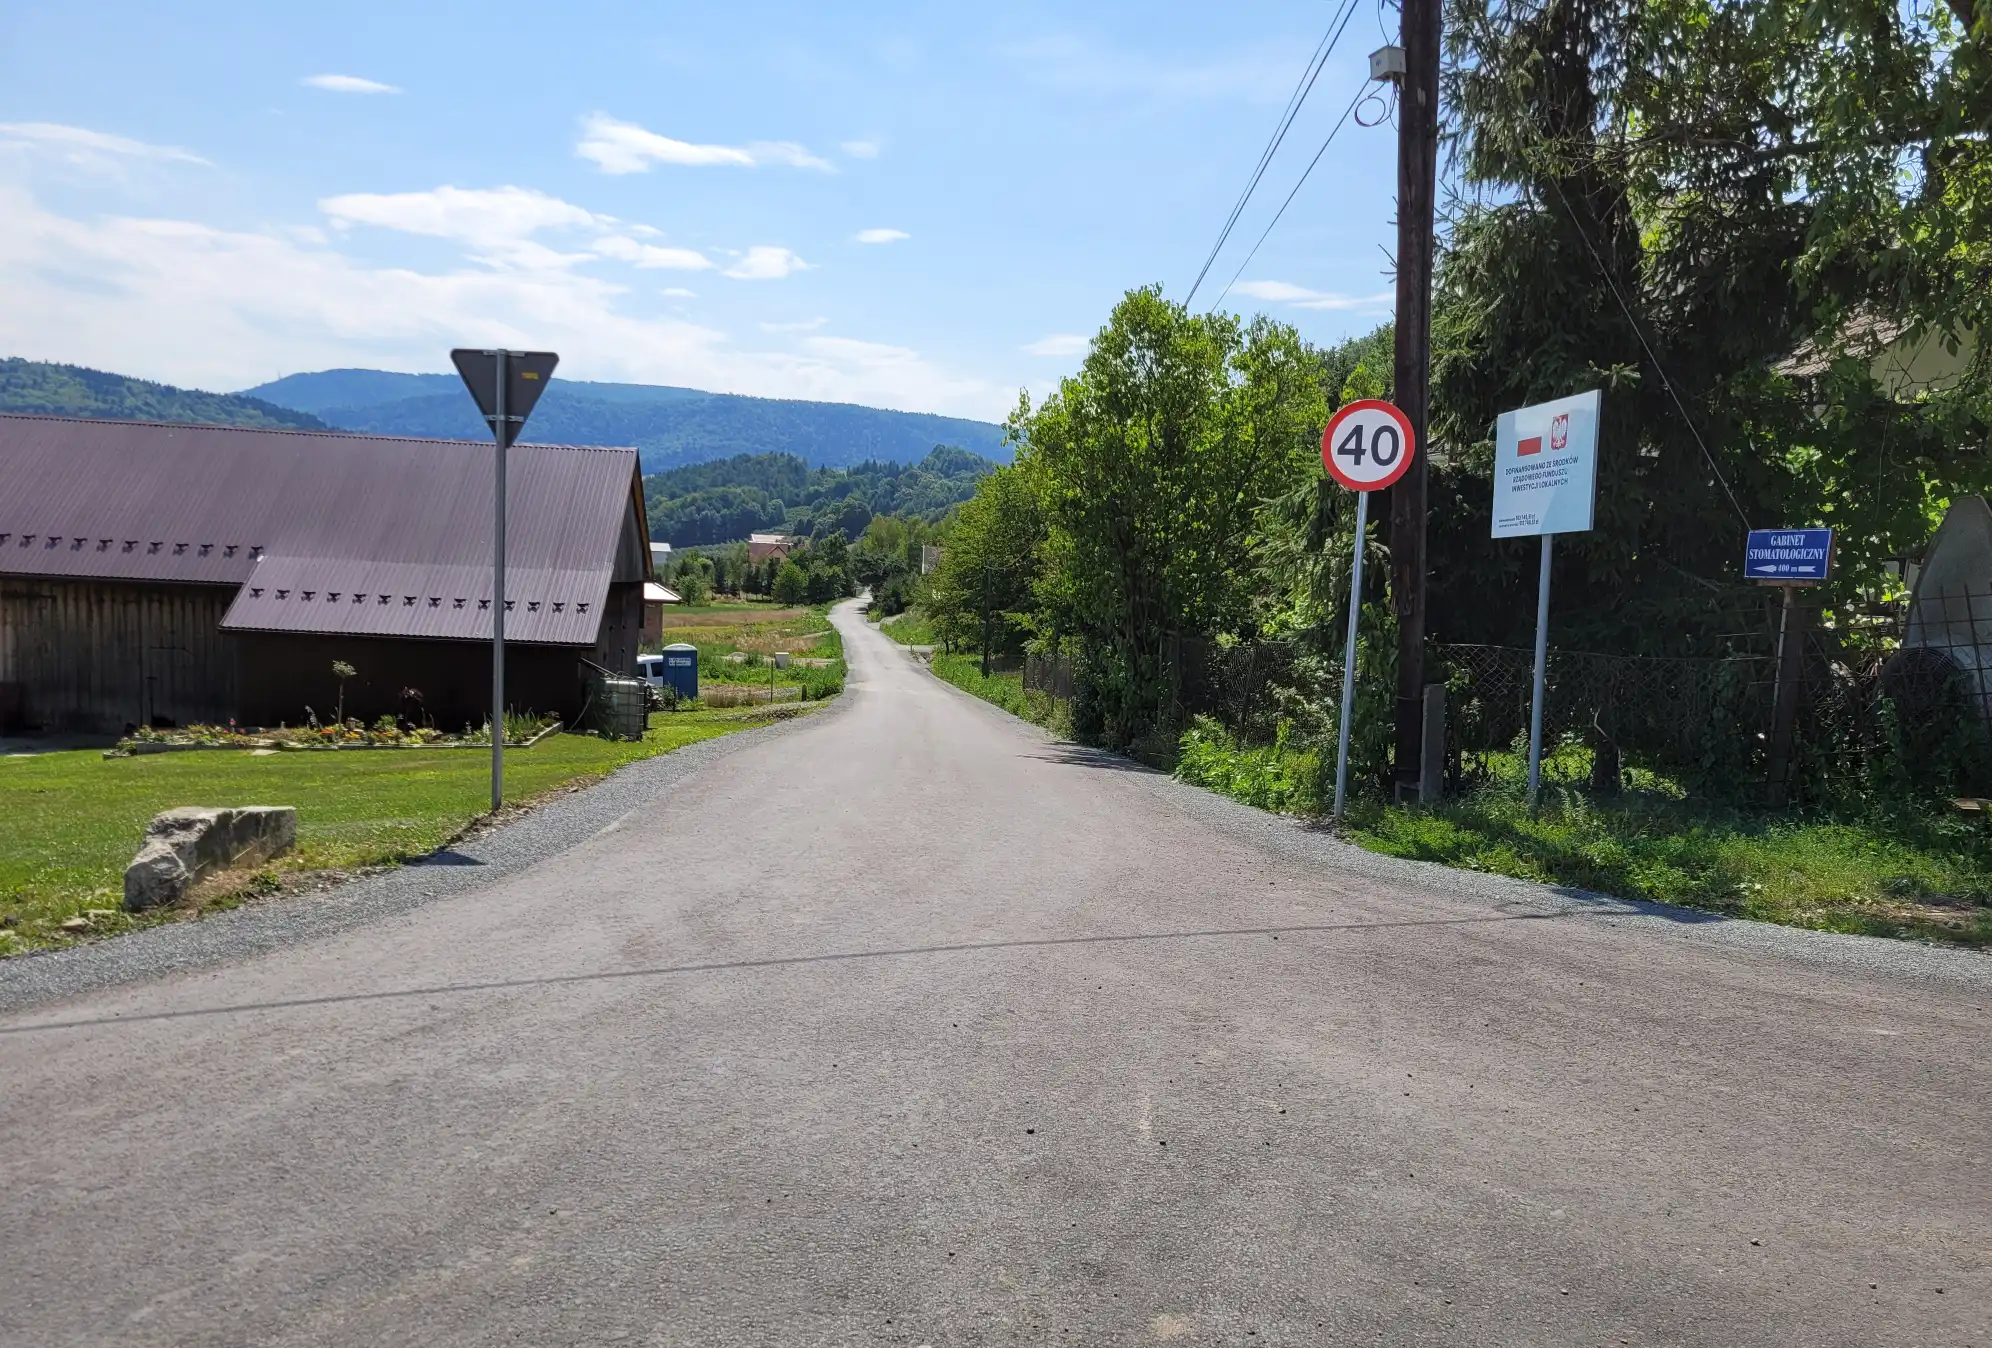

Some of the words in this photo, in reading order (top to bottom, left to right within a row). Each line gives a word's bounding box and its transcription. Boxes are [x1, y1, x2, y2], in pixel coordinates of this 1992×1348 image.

[1337, 425, 1400, 467] 40
[1505, 462, 1546, 476] DOFINANSOWANO
[1546, 461, 1552, 469] ZE
[1511, 481, 1539, 493] INWESTYCJI
[1770, 534, 1806, 547] GABINET
[1749, 548, 1825, 560] STOMATOLOGICZNY
[1777, 564, 1790, 572] 400
